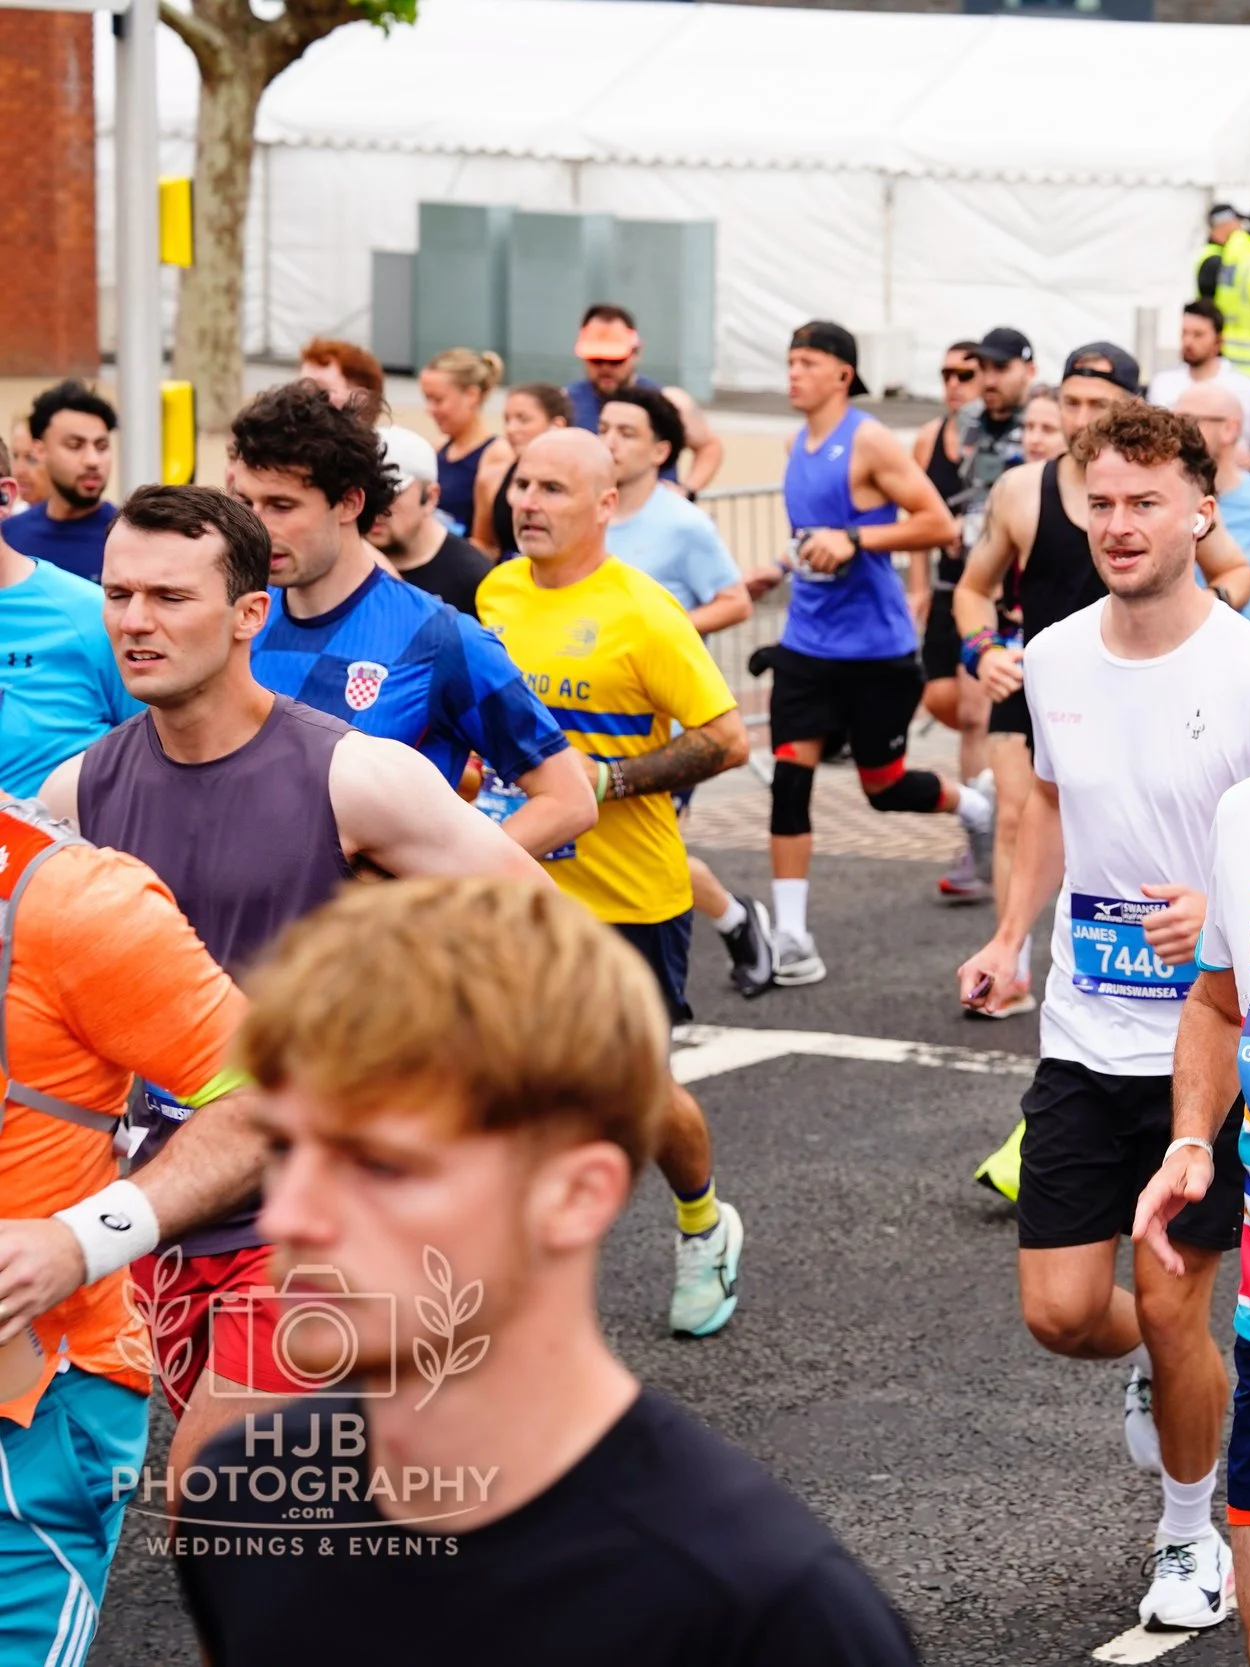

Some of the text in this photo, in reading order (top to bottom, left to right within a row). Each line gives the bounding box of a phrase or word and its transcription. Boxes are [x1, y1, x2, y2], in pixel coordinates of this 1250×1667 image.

[524, 672, 591, 700] ND AC
[1073, 925, 1117, 943] JAMES
[1095, 943, 1175, 978] 7446
[1098, 982, 1177, 998] #RUNSWANSEA
